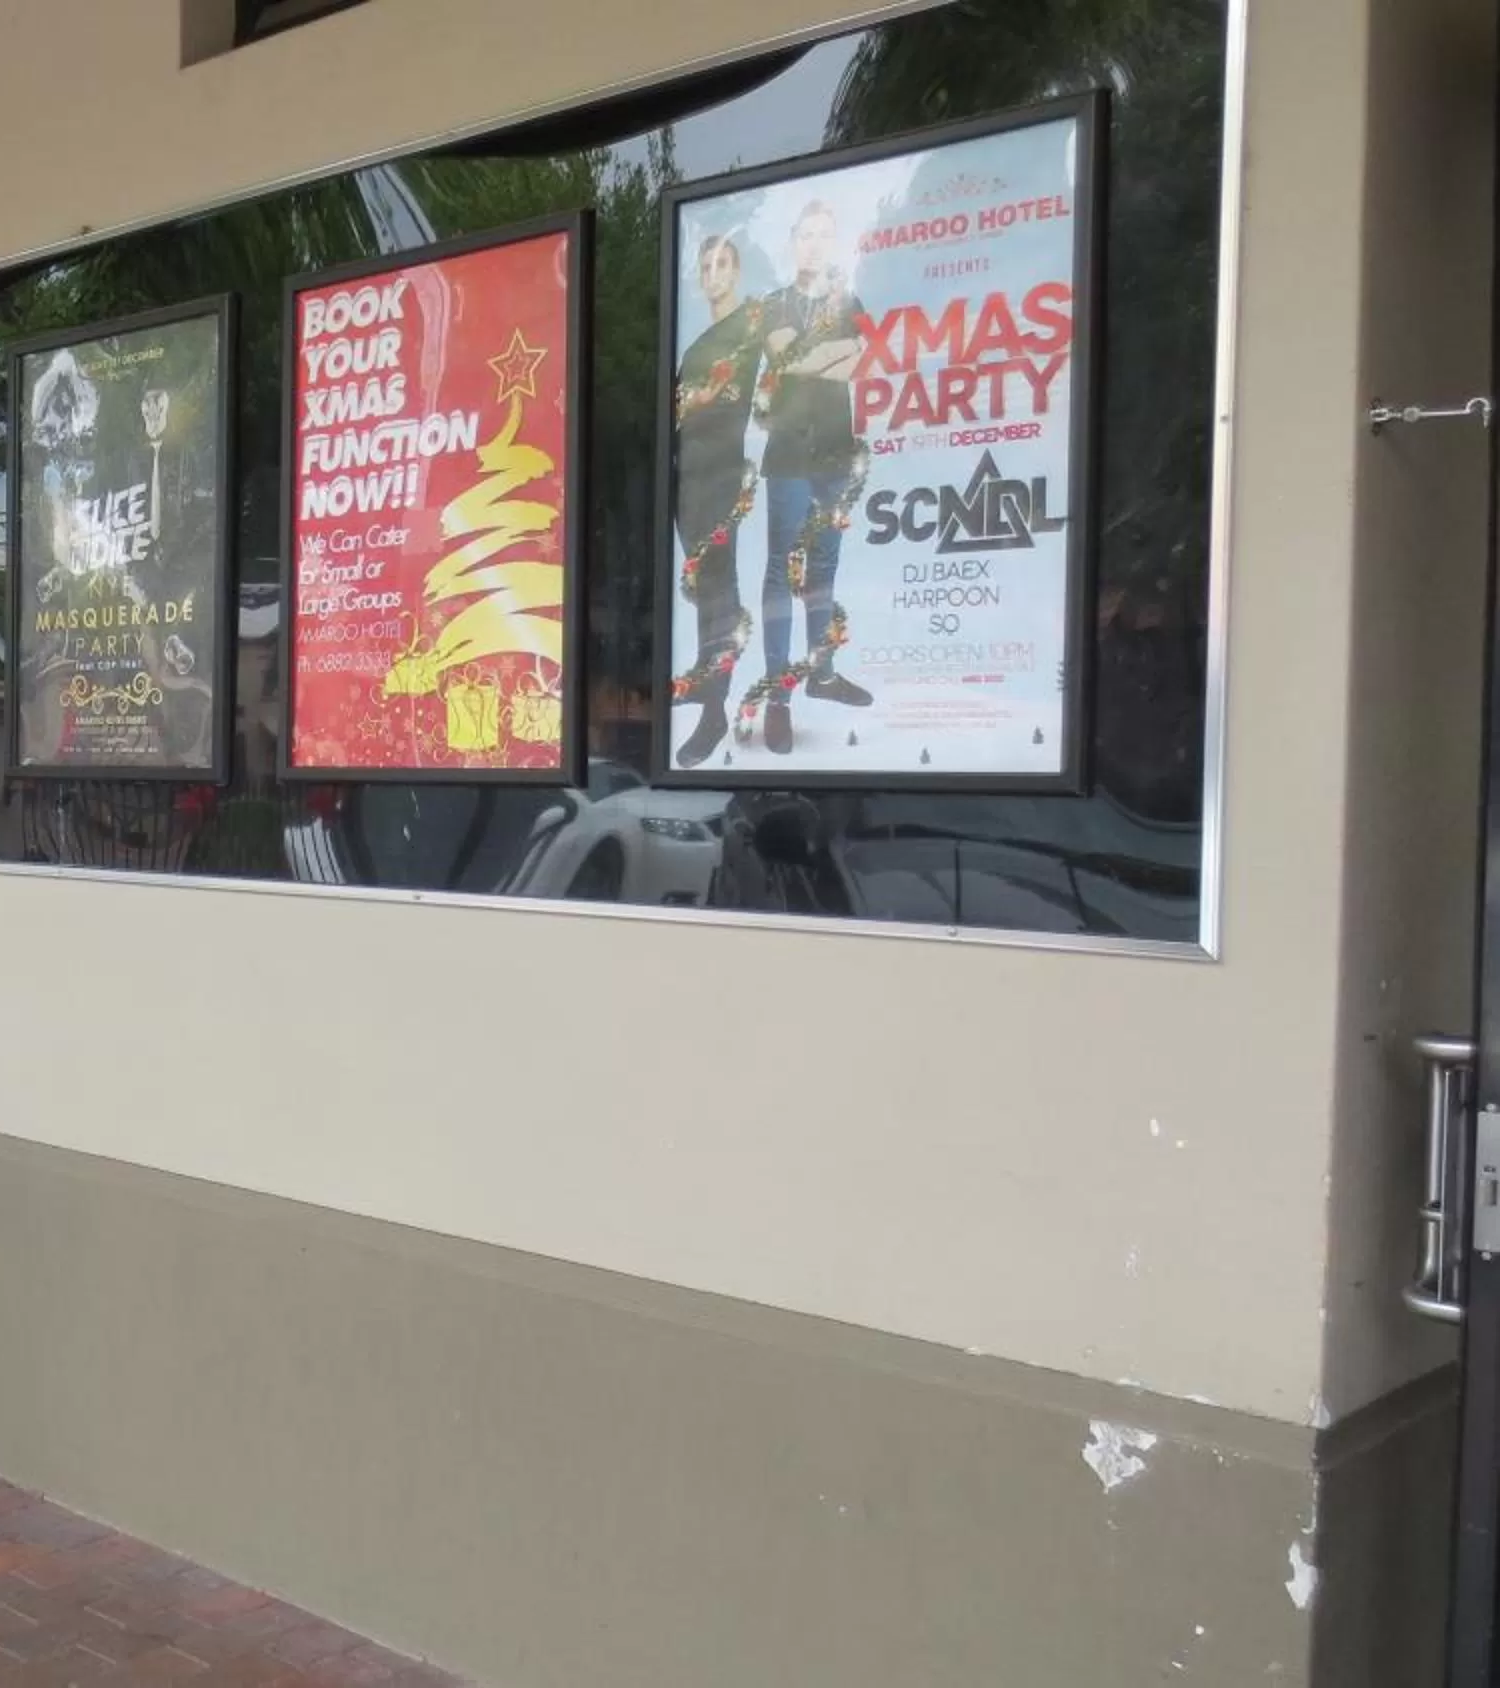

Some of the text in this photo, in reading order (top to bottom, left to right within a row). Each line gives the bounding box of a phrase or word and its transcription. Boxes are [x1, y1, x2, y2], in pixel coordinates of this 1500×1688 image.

[855, 214, 970, 254] AMAROO
[978, 196, 1070, 231] HOTEL
[304, 279, 409, 340] BOOK
[852, 281, 1075, 380] XMAS
[301, 328, 401, 384] YOUR
[301, 374, 407, 430] XMAS
[851, 352, 1068, 435] PARTY
[301, 410, 479, 475] FUNCTION
[873, 436, 906, 455] SAT
[950, 423, 1042, 447] DECEMBER
[301, 464, 421, 521] NOW!!
[301, 524, 410, 555] We Can Cater
[322, 553, 365, 585] Small
[366, 561, 386, 579] or
[903, 559, 990, 583] DJ BAEX
[36, 597, 195, 633] MASQUERADE
[343, 588, 403, 616] Groups
[893, 585, 1000, 609] HARPOON
[75, 633, 145, 657] PARTY
